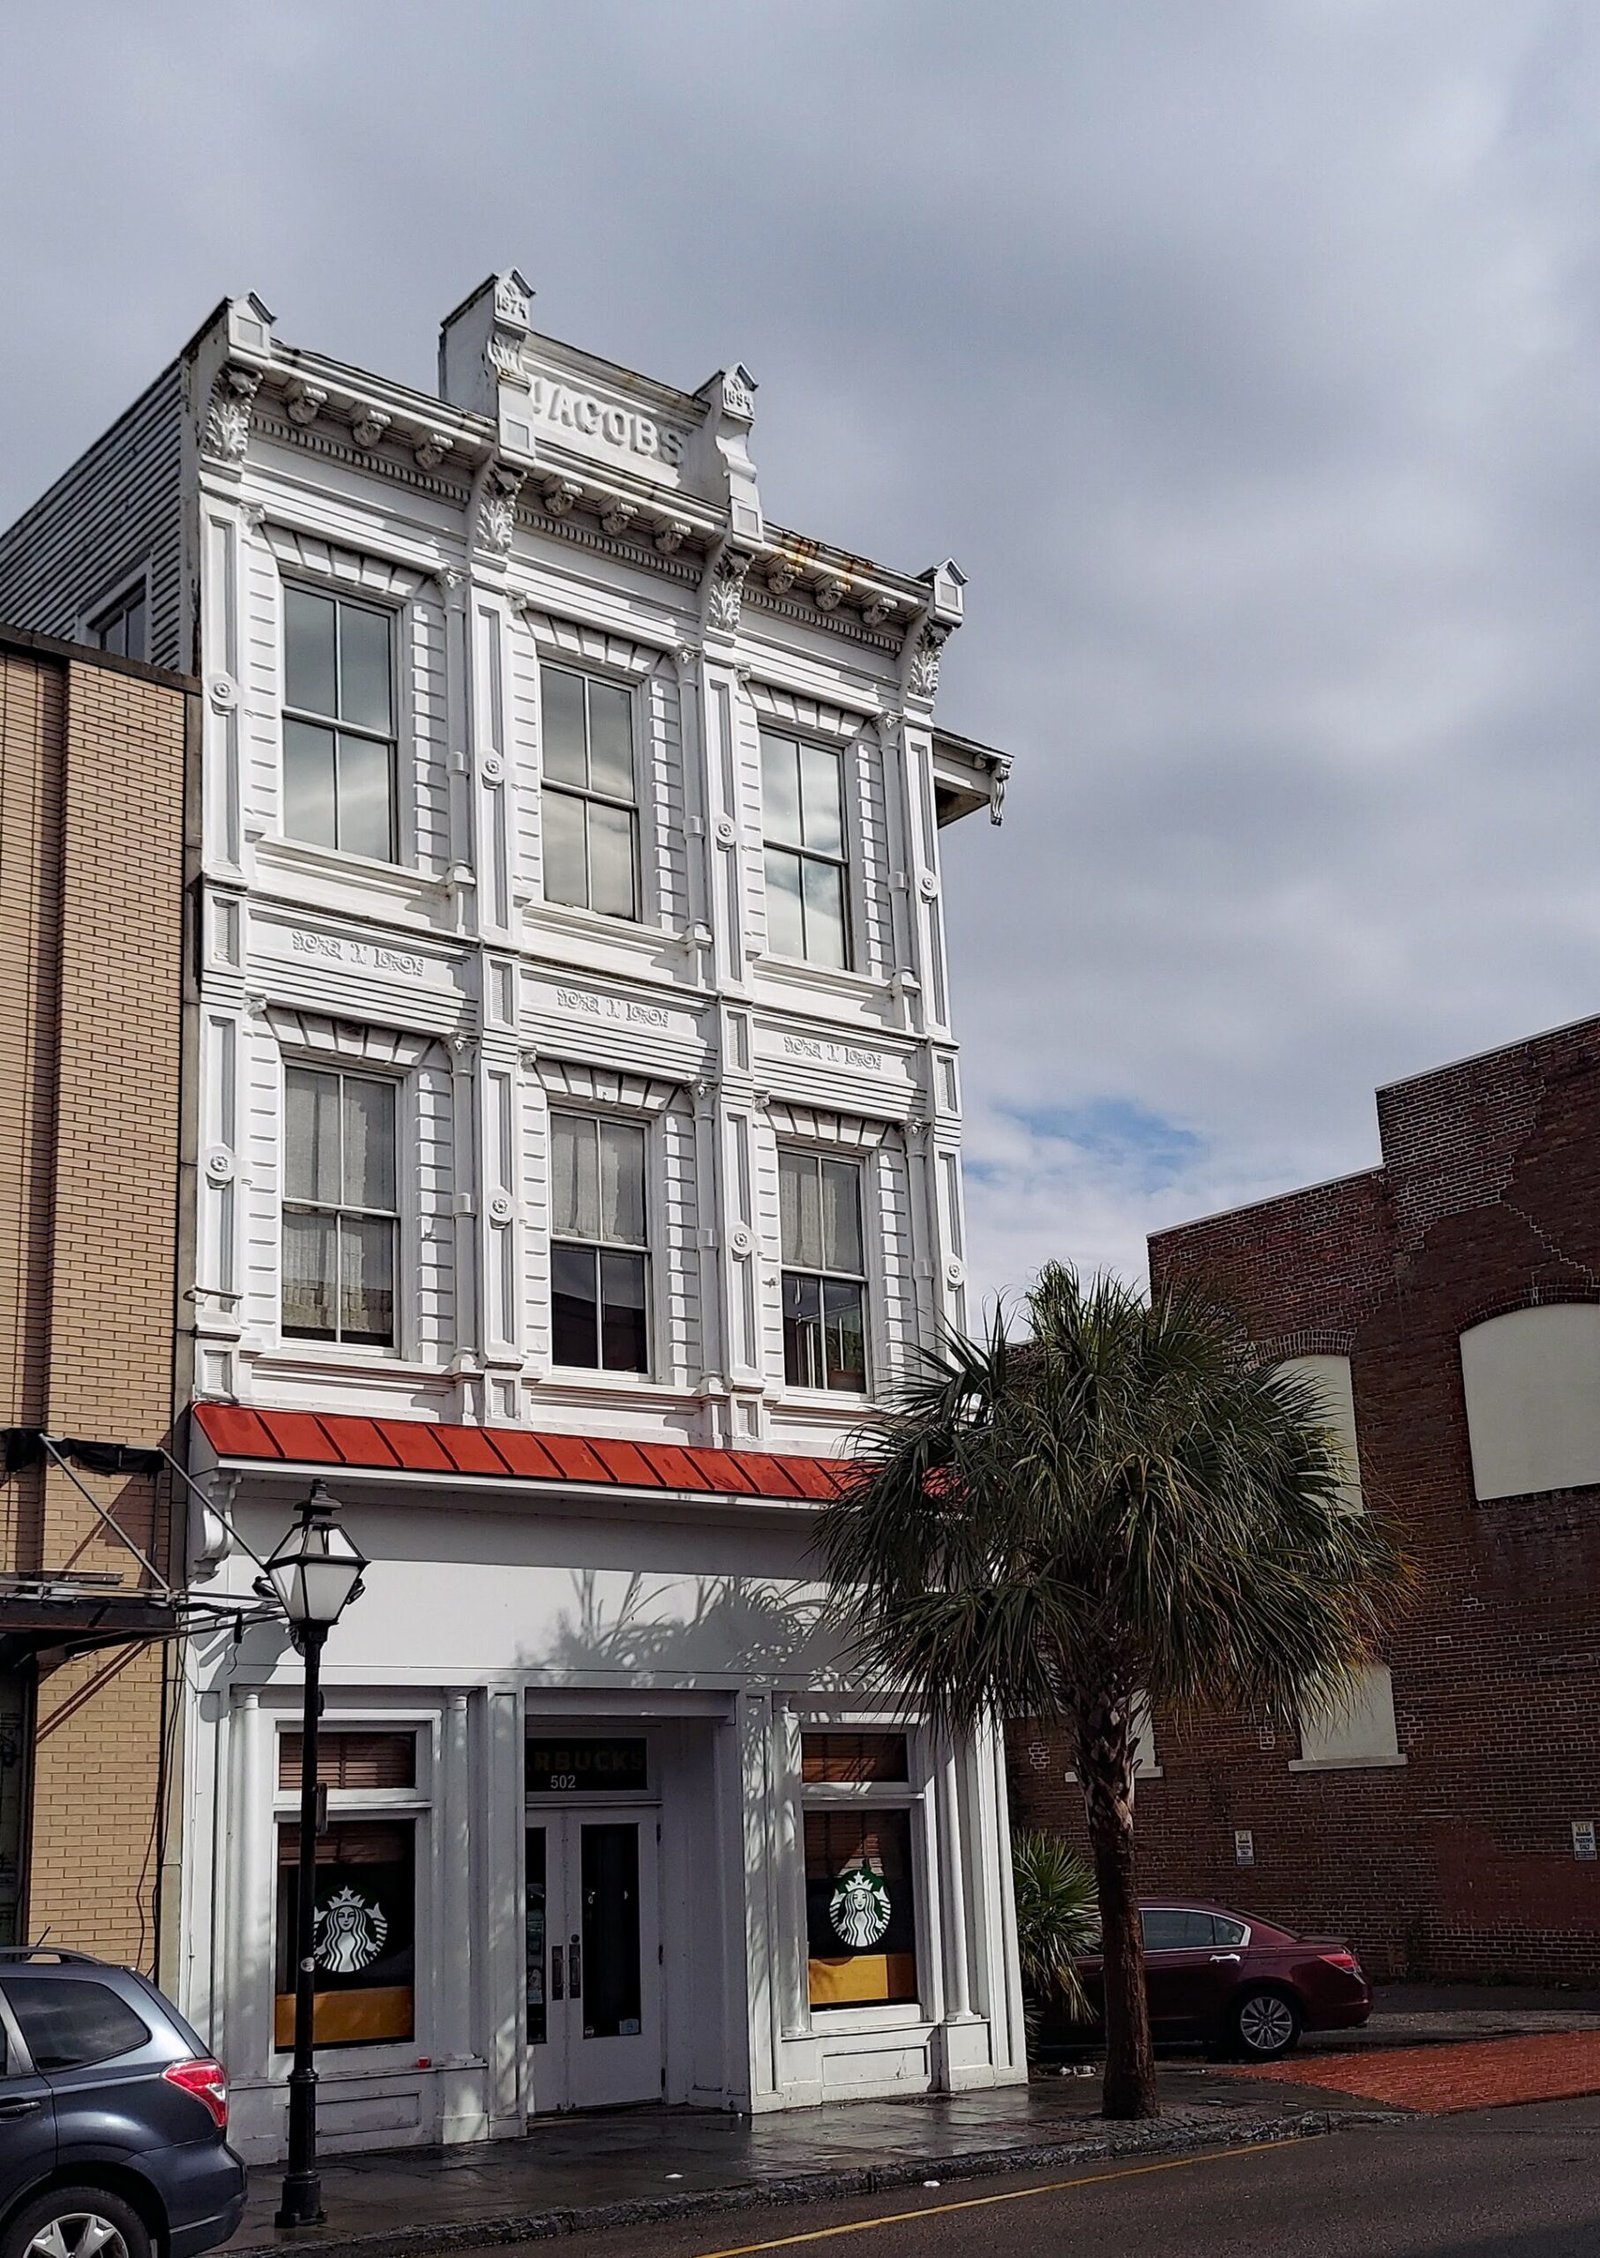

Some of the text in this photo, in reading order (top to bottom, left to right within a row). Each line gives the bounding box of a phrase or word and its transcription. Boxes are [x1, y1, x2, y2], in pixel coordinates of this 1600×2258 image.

[532, 376, 684, 467] JACOBS
[527, 1751, 642, 1771] RBUCKS
[550, 1774, 576, 1789] 502
